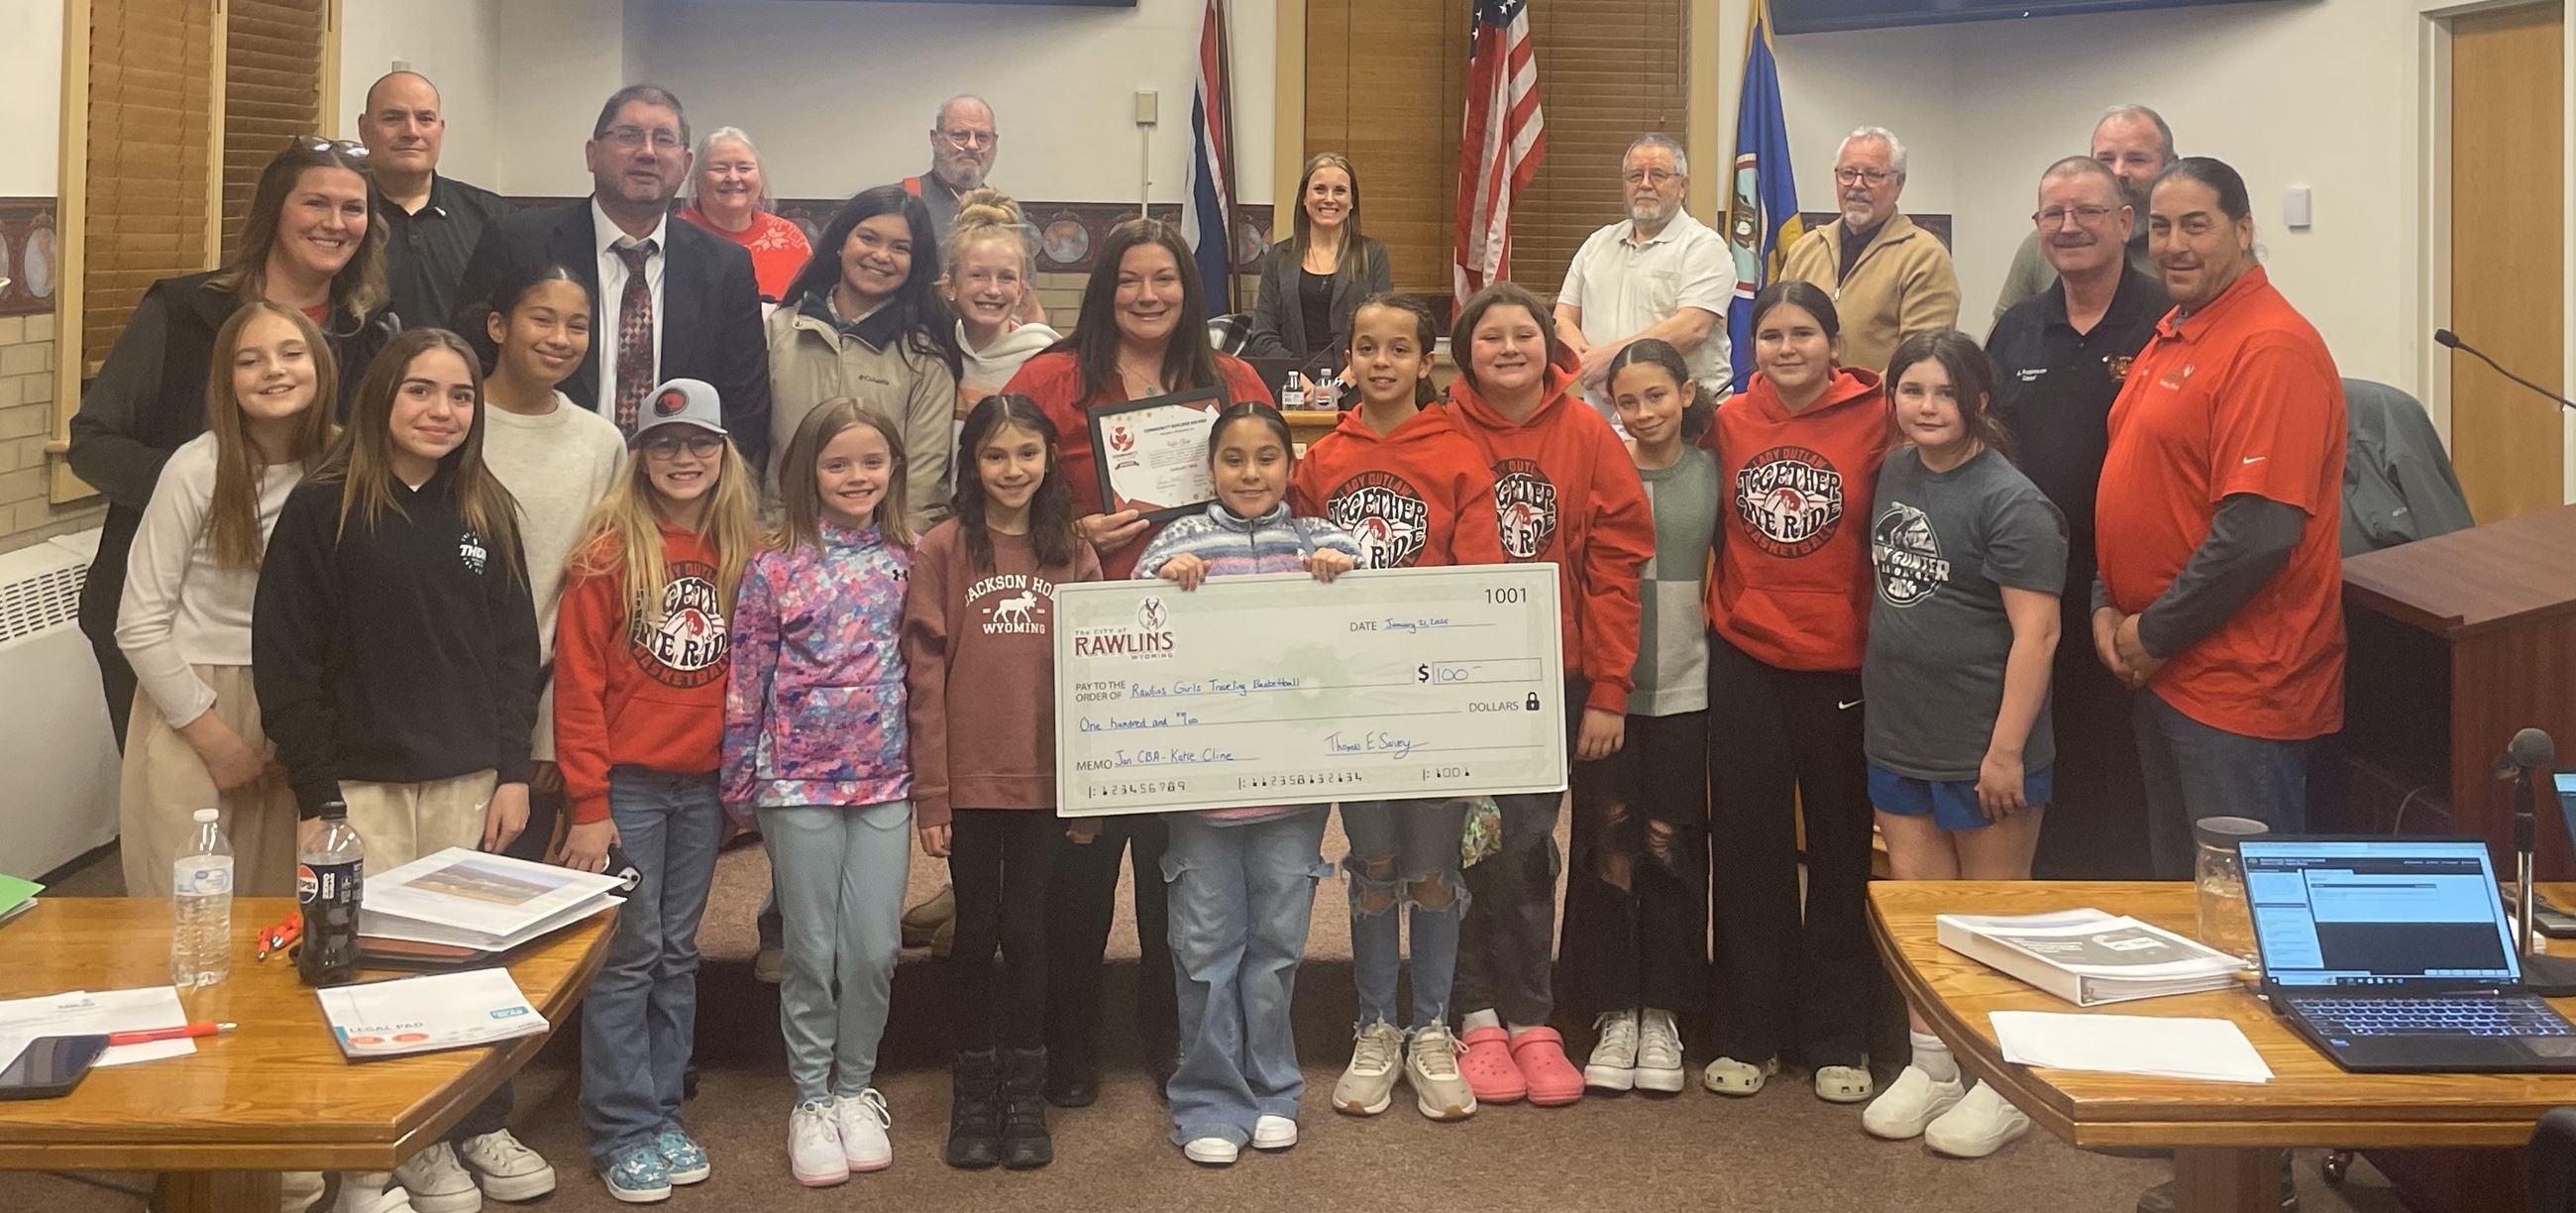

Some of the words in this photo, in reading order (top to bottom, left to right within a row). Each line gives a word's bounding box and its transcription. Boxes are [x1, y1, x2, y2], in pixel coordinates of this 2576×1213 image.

[1737, 460, 1842, 501] TOGETHER
[1327, 487, 1428, 529] TOGETHER
[1736, 496, 1777, 536] WE
[1782, 500, 1842, 539] RIDE
[1891, 550, 1951, 582] GUNTER
[965, 574, 1027, 607] JACKSON
[1485, 587, 1527, 605] 1001
[983, 622, 1046, 635] WYOMING
[1349, 621, 1377, 632] DATE
[1075, 631, 1174, 657] RAWLINS
[1438, 668, 1468, 682] 100
[1076, 683, 1093, 692] PAY
[1095, 682, 1107, 691] TO
[1109, 681, 1127, 690] THE
[1131, 683, 1167, 698] Rawlins
[1173, 681, 1202, 695] Girls
[1075, 694, 1107, 703] ORDER
[1110, 692, 1122, 701] OF
[1469, 702, 1519, 713] DOLLARS
[1079, 716, 1102, 732] One
[1110, 717, 1147, 729] hundred
[1152, 717, 1169, 727] and
[1366, 730, 1375, 750] E
[1202, 747, 1234, 762] Cline
[1076, 759, 1113, 772] MEMO
